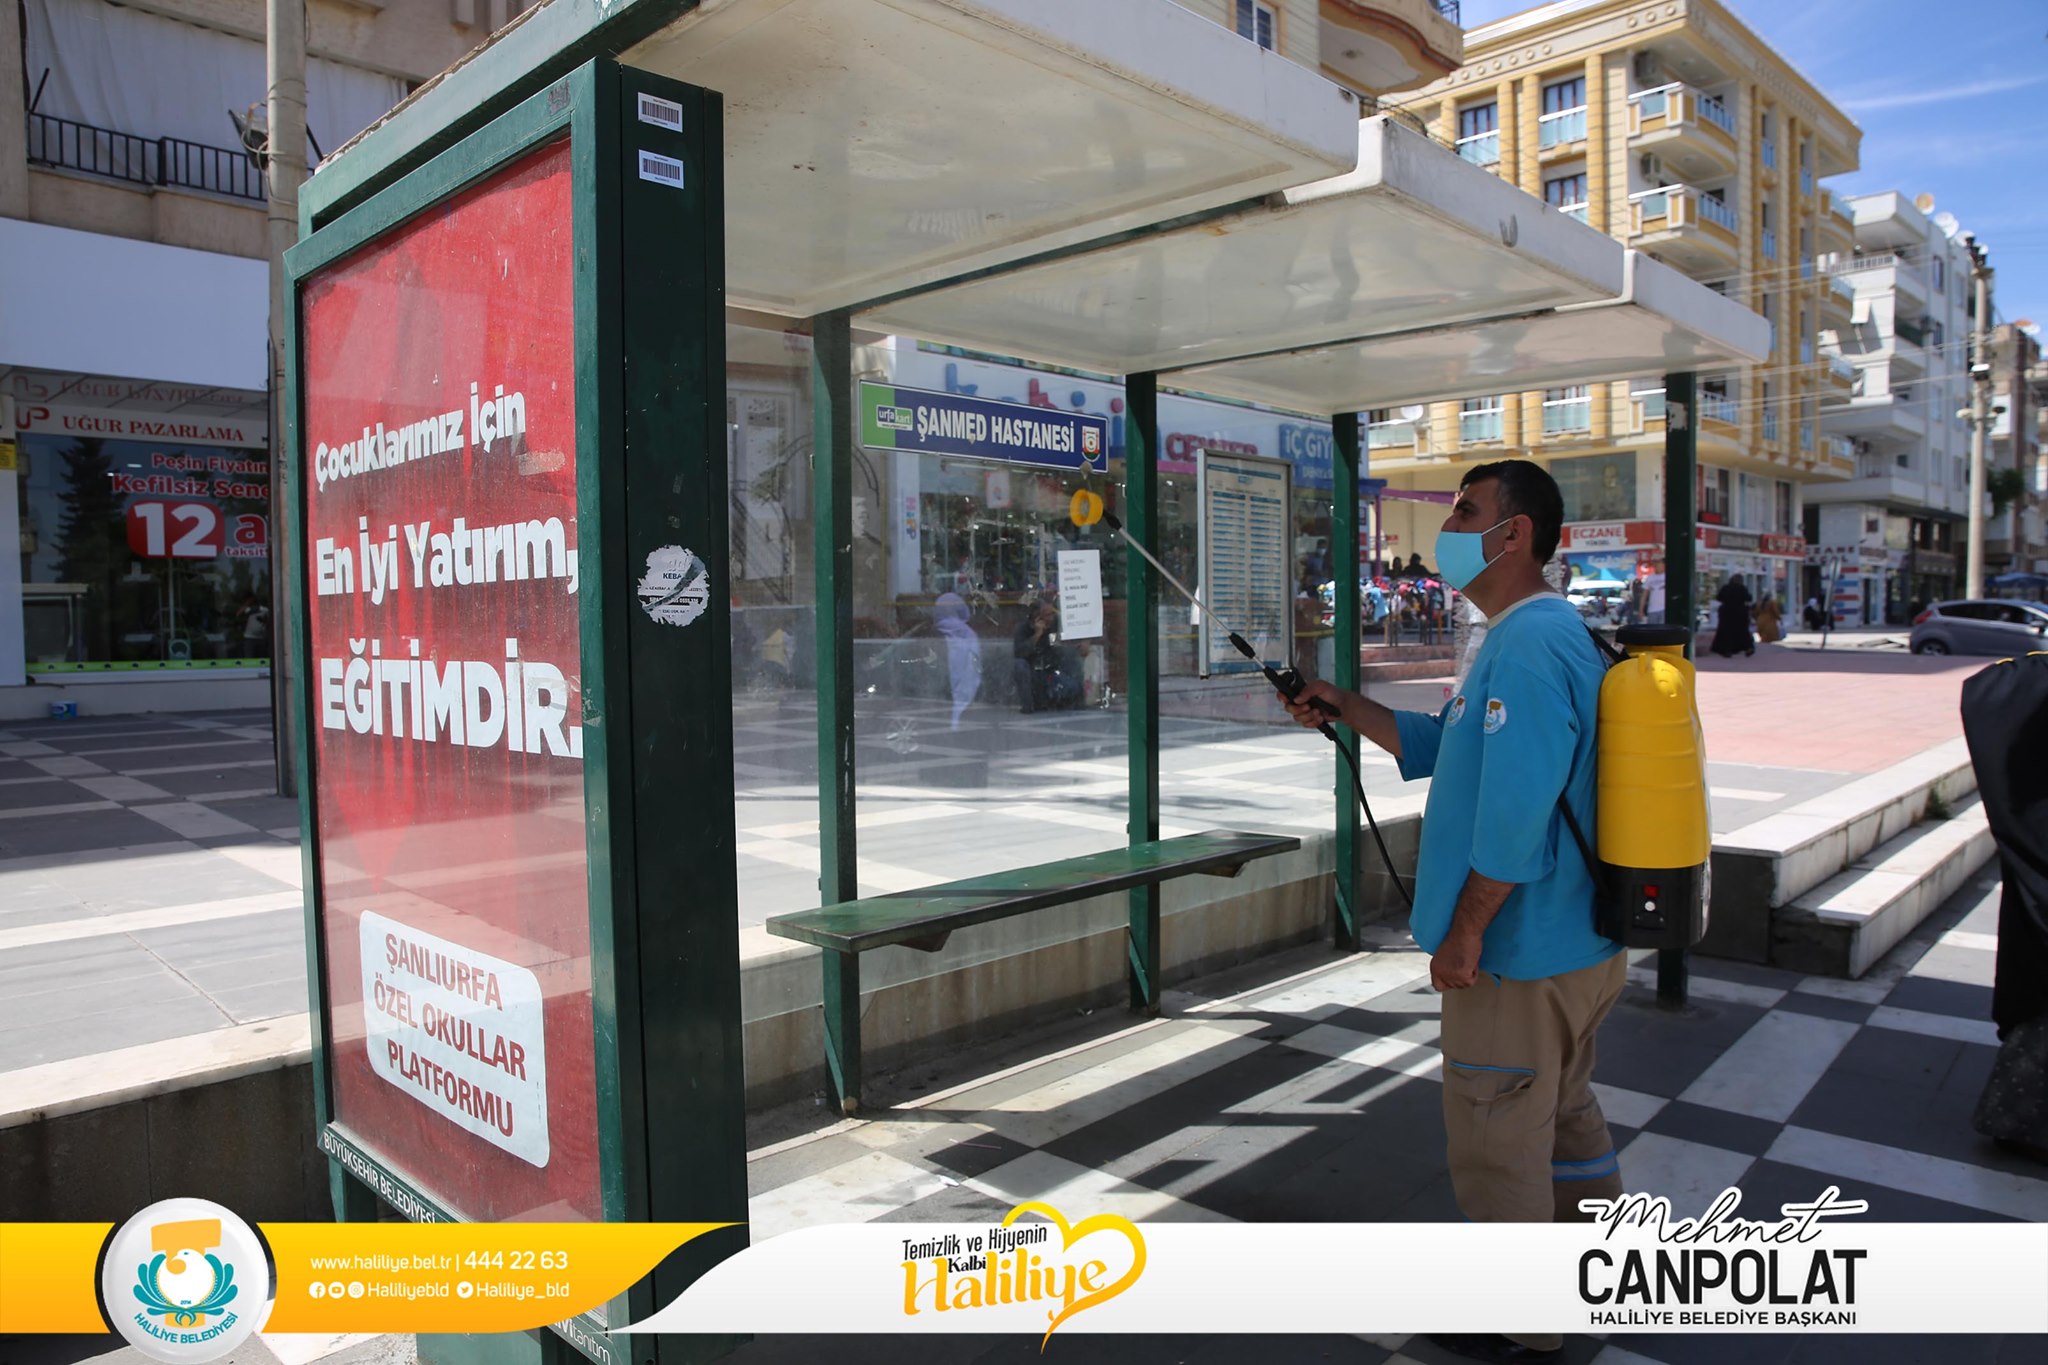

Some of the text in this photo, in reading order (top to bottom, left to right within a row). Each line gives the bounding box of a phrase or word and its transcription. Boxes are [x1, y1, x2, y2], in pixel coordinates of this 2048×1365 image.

[63, 415, 123, 432] UĞUR
[129, 420, 245, 442] PAZARLAMA
[152, 452, 204, 471] Peşin
[315, 381, 526, 492] Çocuklarımız İçin
[917, 406, 987, 442] ŞANMED
[991, 415, 1075, 453] HASTANESİ
[112, 474, 209, 497] Kefilsiz
[134, 502, 217, 557] 12
[316, 516, 578, 605] En İyi Yatırım,
[1573, 527, 1622, 539] ECZANE
[320, 638, 583, 758] EĞİTİMDİR.
[385, 933, 503, 1011] ŞANLIURFA
[374, 972, 527, 1081] ÖZEL OKULLAR
[387, 1039, 514, 1137] PLATFORMU
